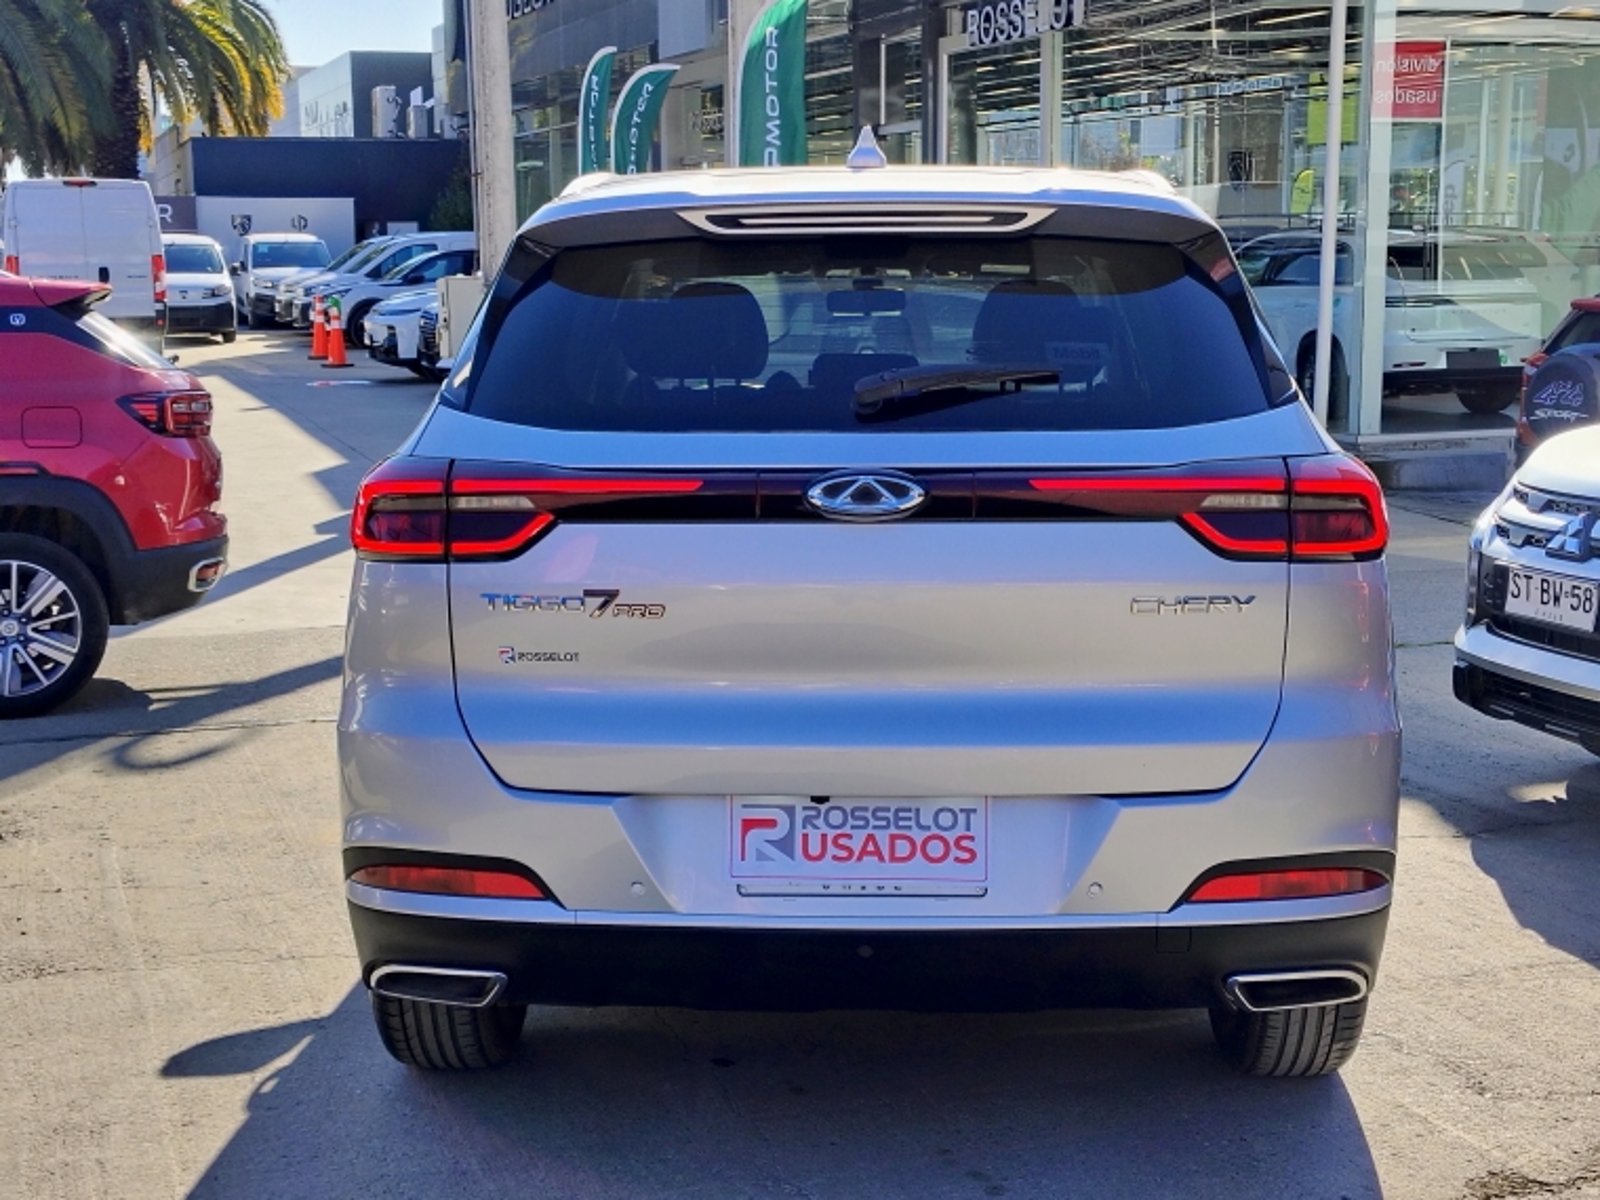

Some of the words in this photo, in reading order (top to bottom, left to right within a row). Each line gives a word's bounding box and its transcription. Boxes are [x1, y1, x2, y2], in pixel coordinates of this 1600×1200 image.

[613, 603, 666, 619] PRO
[1130, 595, 1256, 615] CHERY
[517, 651, 580, 662] ROSSELOT
[802, 806, 977, 832] ROSSELOT
[802, 833, 978, 864] USADOS
